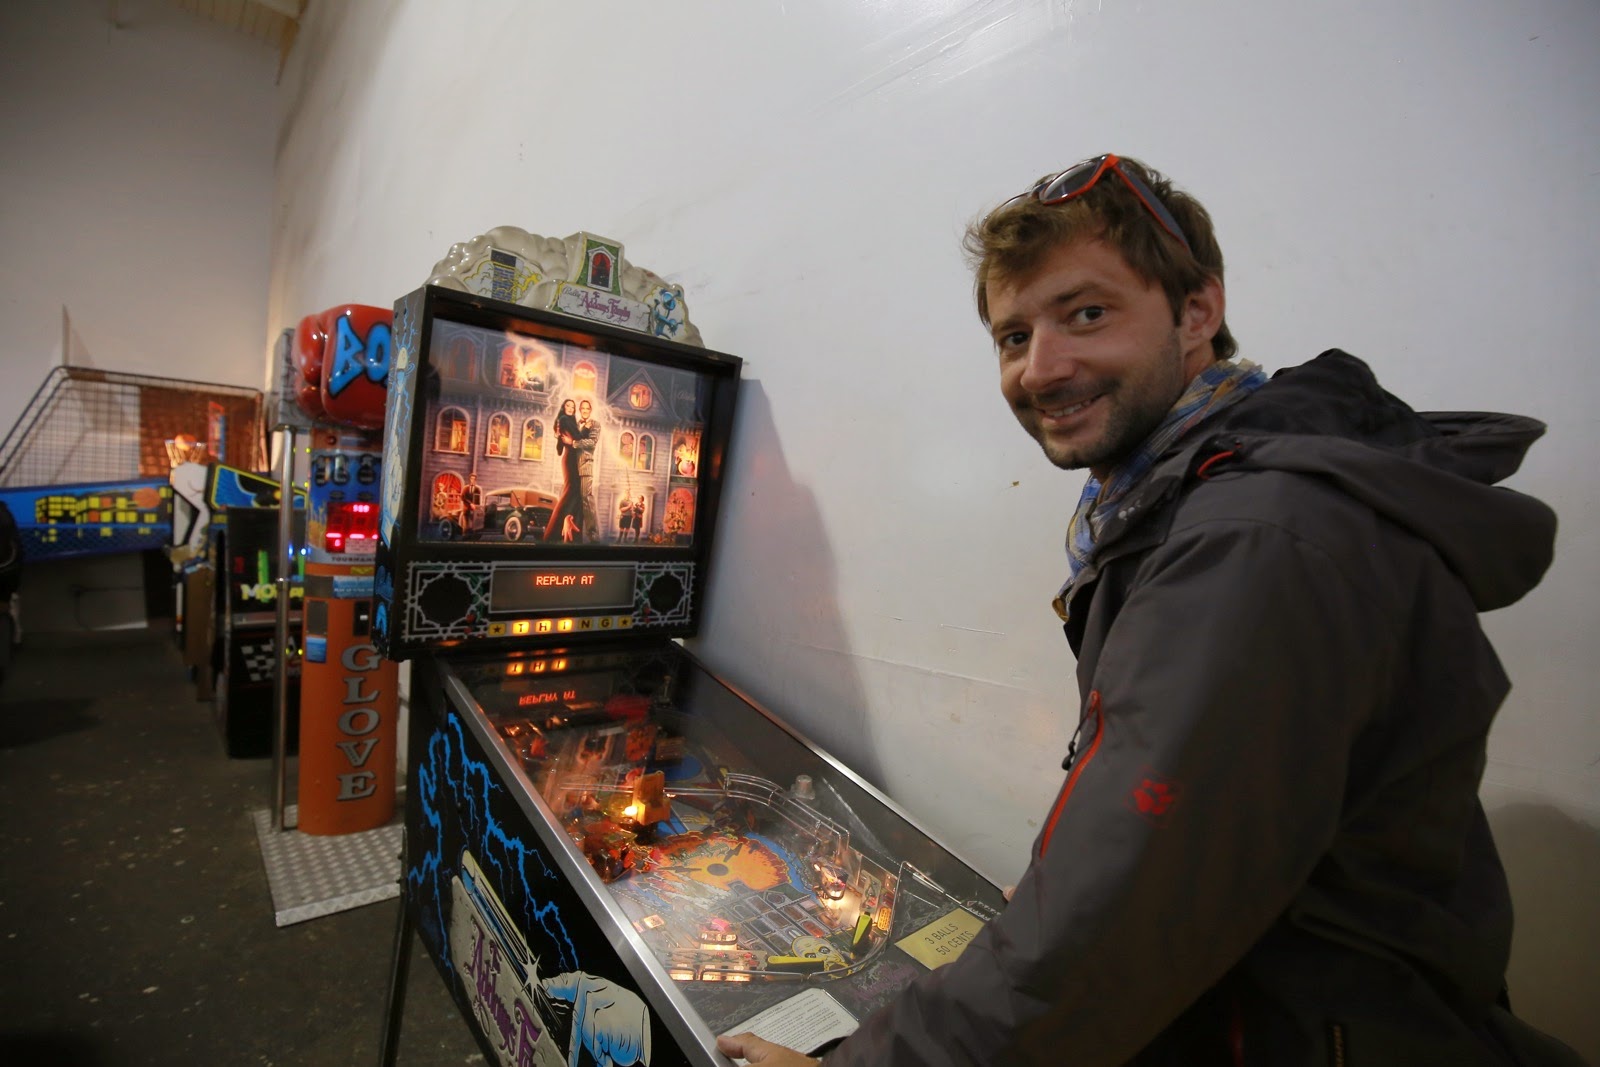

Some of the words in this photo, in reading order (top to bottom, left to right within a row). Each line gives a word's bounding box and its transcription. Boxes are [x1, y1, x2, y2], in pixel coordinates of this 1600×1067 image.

[328, 315, 391, 399] BO
[536, 576, 576, 586] REPLAY
[580, 575, 594, 585] AT
[336, 644, 383, 802] GLOVE
[924, 937, 935, 945] 3
[931, 923, 959, 941] BALLS
[935, 945, 951, 956] 50
[947, 931, 975, 948] CENTS
